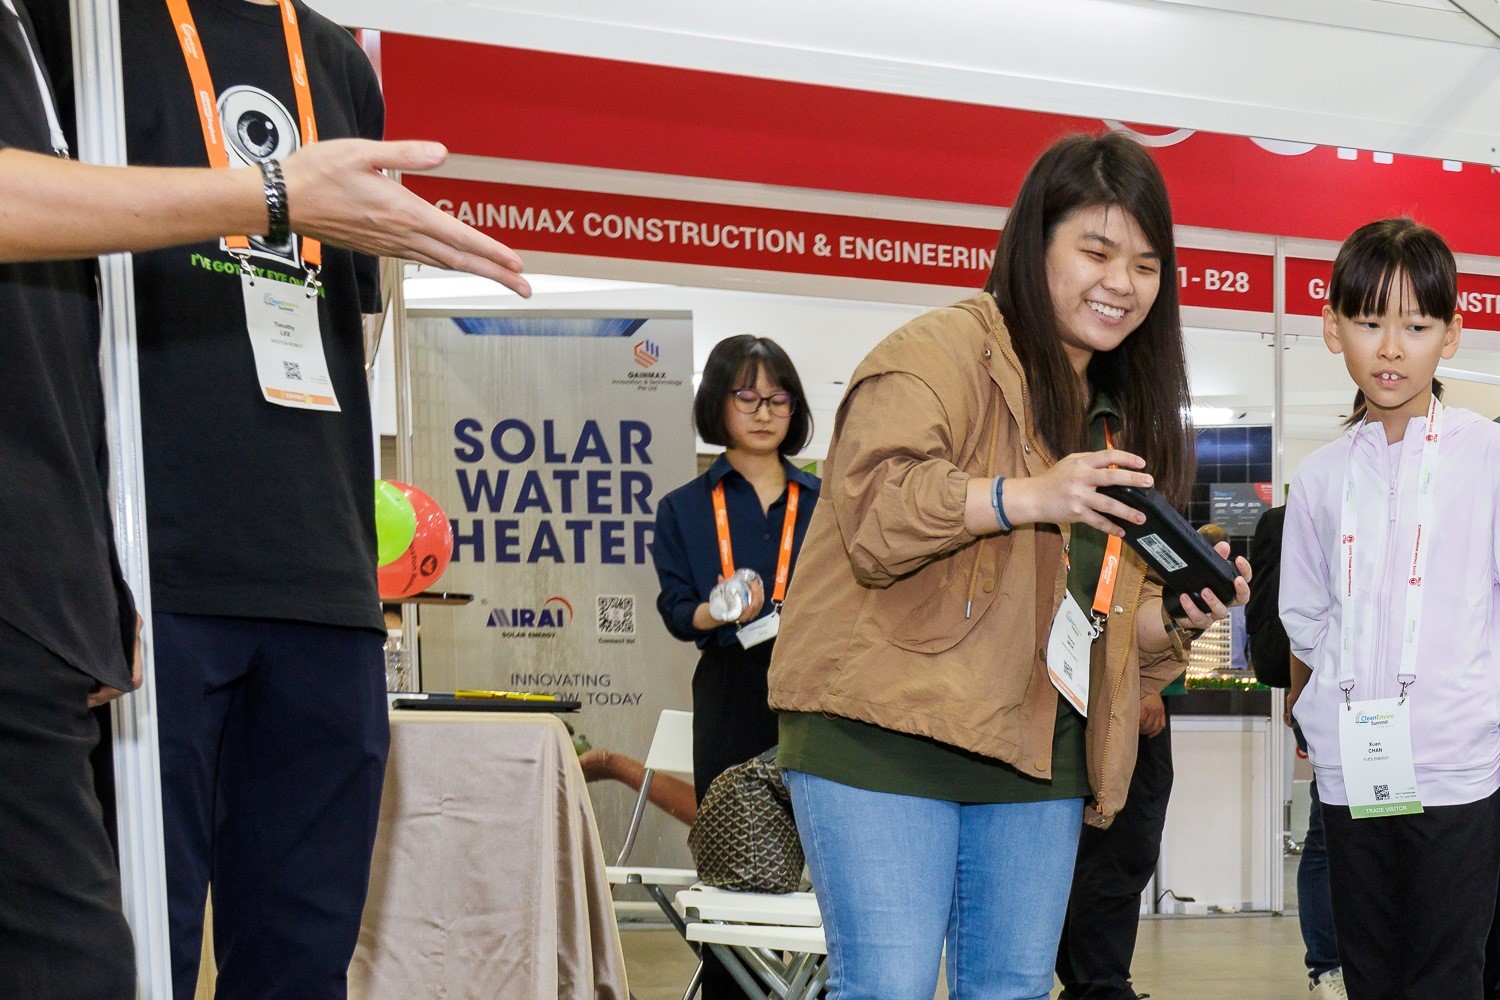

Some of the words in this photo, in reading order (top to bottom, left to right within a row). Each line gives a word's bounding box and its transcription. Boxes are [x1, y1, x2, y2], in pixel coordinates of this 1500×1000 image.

[582, 212, 805, 255] CONSTRUCTION
[813, 234, 832, 257] &
[839, 235, 997, 271] ENGINEERIN
[1178, 265, 1249, 293] 1-B28
[454, 418, 653, 464] SOLAR
[456, 469, 653, 514] WATER
[511, 673, 611, 688] INNOVATING
[586, 692, 643, 706] TODAY
